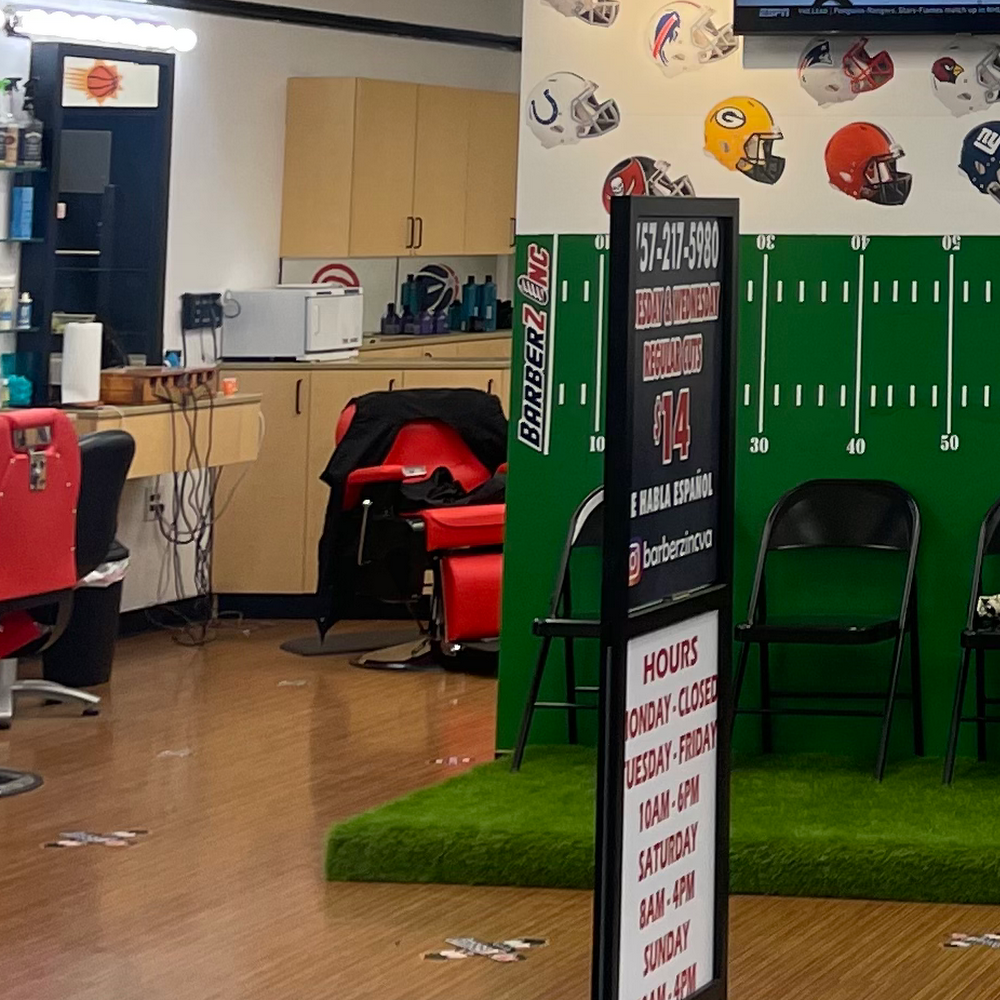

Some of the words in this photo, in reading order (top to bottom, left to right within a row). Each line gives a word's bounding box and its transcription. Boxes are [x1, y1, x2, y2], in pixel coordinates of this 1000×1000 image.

[636, 221, 720, 273] 57-217-5980
[672, 281, 720, 325] WEDNESDAY
[519, 304, 547, 451] BARBERZ
[643, 336, 682, 381] REGULAR
[683, 332, 703, 375] CUTS
[590, 436, 606, 453] 10
[653, 387, 691, 466] $14
[750, 437, 769, 454] 30
[846, 438, 866, 455] 40
[940, 434, 959, 451] 50
[639, 483, 672, 516] HABLA
[673, 468, 714, 506] ESPAÑOL
[643, 528, 714, 570] barberzincva
[643, 635, 699, 685] HOURS
[678, 673, 719, 718] CLOSED
[679, 720, 718, 766] FRIDAY
[639, 788, 670, 834] 10AM
[677, 773, 701, 814] 6PM
[637, 821, 699, 883] SATURDAY
[638, 886, 666, 931] 8AM
[672, 869, 696, 910] 4PM
[642, 918, 691, 978] SUNDAY
